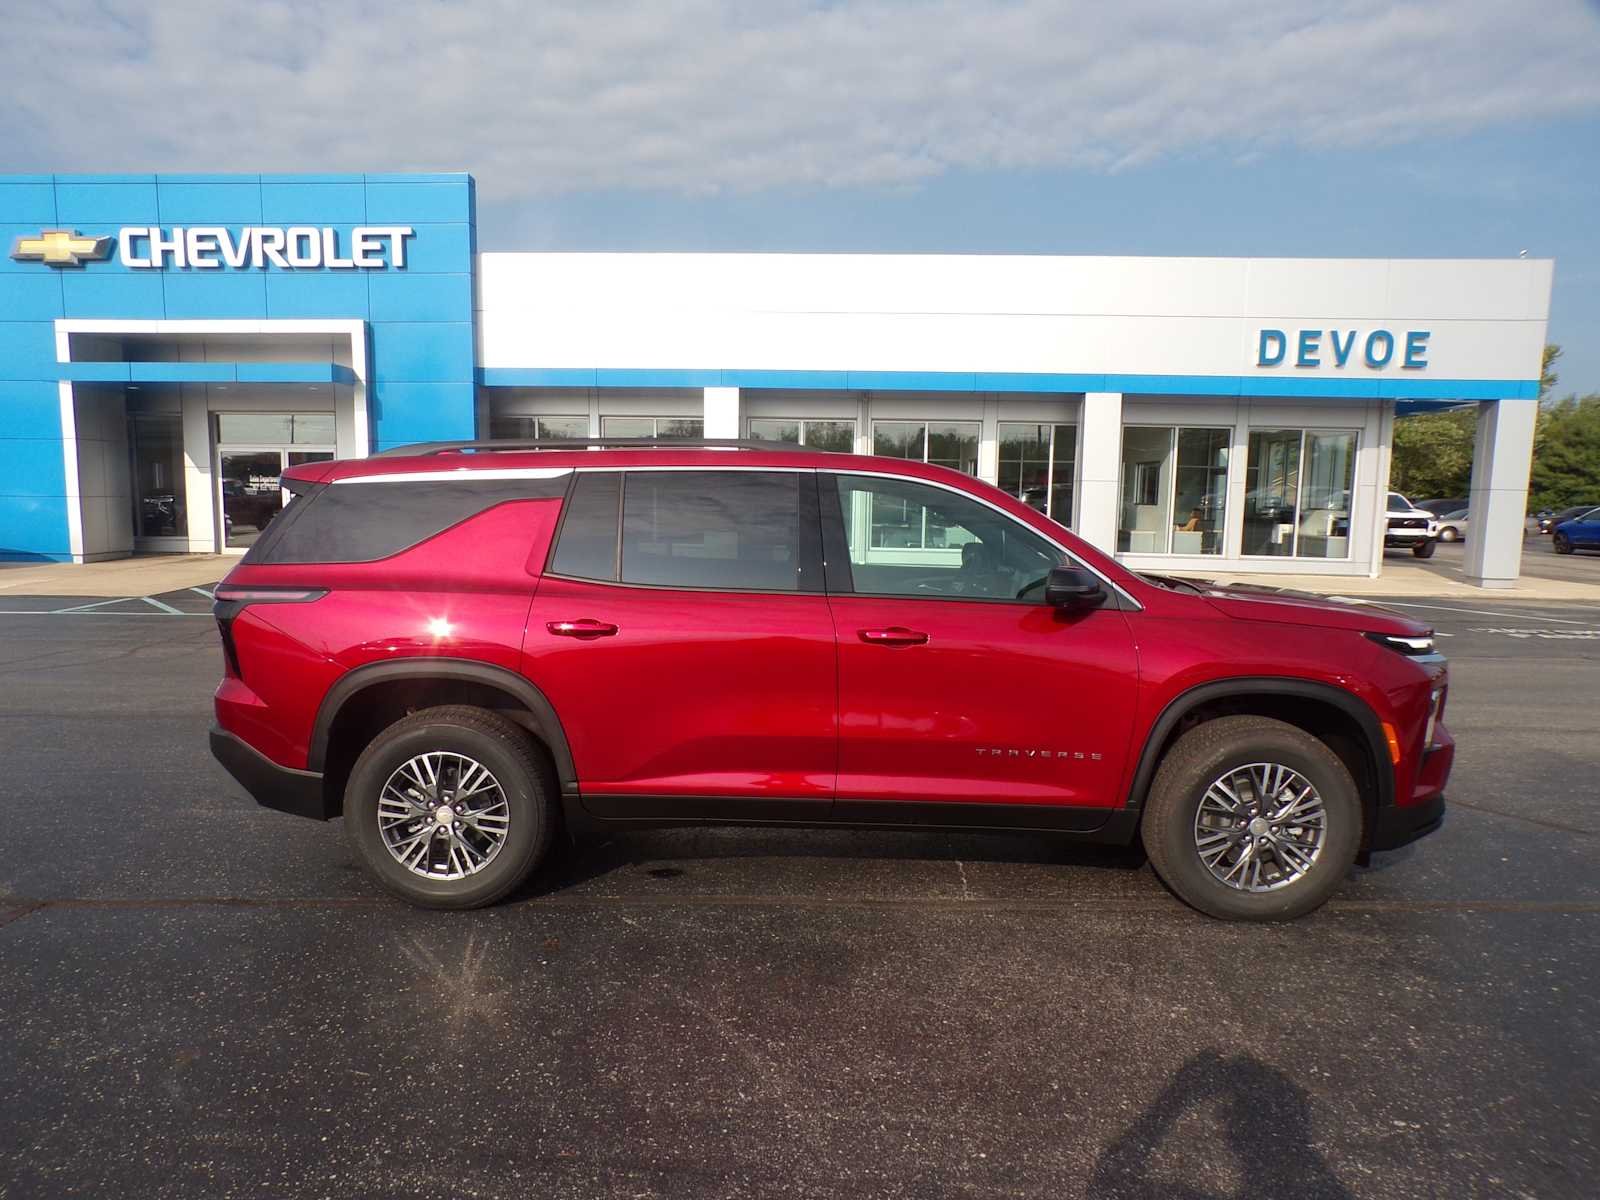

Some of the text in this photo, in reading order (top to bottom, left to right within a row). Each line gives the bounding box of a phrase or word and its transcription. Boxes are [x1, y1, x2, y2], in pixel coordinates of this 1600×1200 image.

[119, 227, 412, 267] CHEVROLET
[1258, 329, 1431, 368] DEVOE
[975, 748, 1102, 760] TRAVERSE
